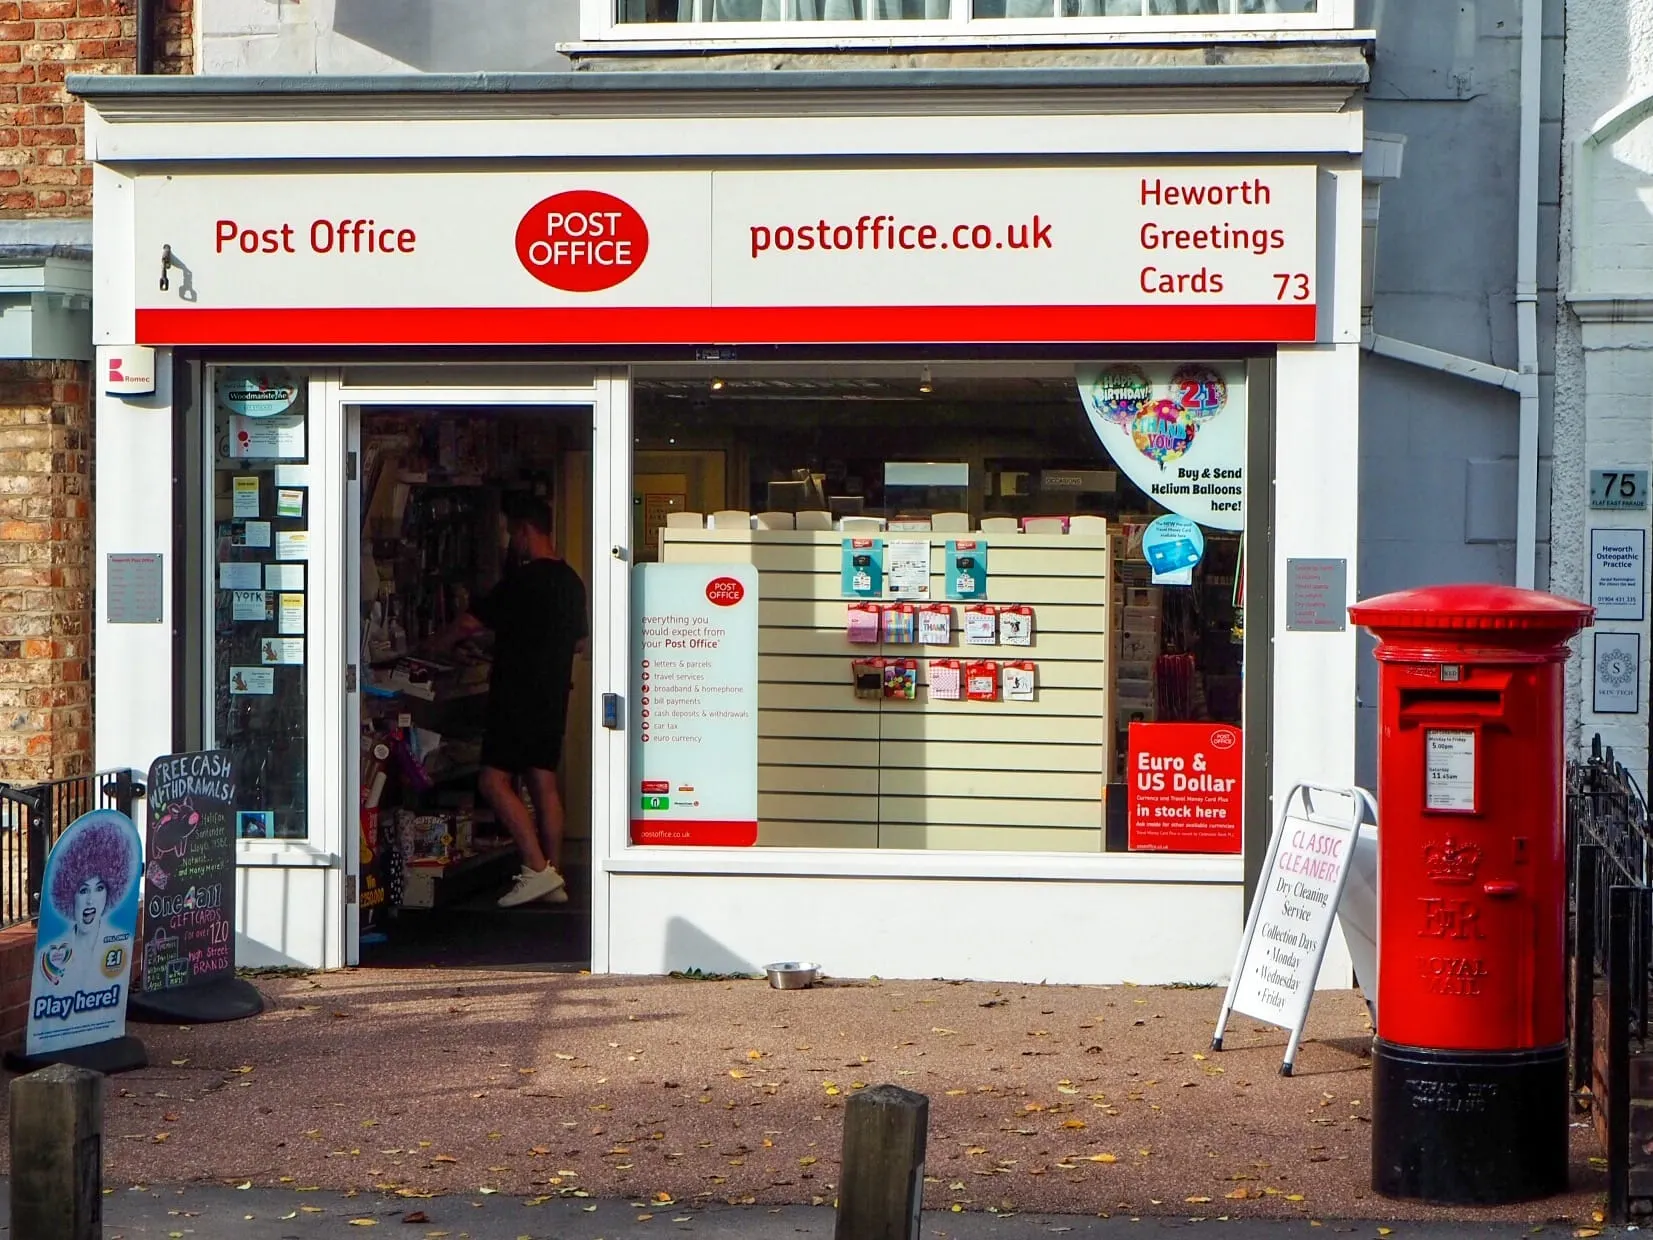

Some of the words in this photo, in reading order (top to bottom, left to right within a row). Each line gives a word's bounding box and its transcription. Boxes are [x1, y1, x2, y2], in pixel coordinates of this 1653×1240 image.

[1140, 179, 1271, 205] Heworth
[546, 211, 621, 236] POST
[215, 219, 295, 254] Post
[310, 219, 416, 254] Office
[750, 215, 1053, 258] postoffice.co.uk
[1140, 222, 1285, 255] Greetings
[528, 241, 632, 266] OFFICE
[1140, 266, 1224, 294] Cards
[1273, 273, 1310, 301] 73
[1098, 387, 1150, 401] BIRTHDAY!
[1180, 380, 1218, 408] 21
[1140, 416, 1186, 440] THANK
[1147, 433, 1174, 450] YOU
[1178, 468, 1199, 481] Buy
[1201, 468, 1211, 479] &
[1213, 468, 1242, 479] Send
[1151, 483, 1190, 495] Helium
[1192, 484, 1242, 495] Balloons
[1602, 473, 1636, 498] 75
[1211, 500, 1242, 511] here!
[709, 592, 740, 600] OFFICE
[714, 583, 736, 591] POST
[641, 616, 689, 626] everything
[692, 617, 709, 626] you
[641, 627, 669, 636] would
[671, 628, 701, 639] expect
[703, 627, 726, 636] from
[641, 641, 661, 649] your
[665, 639, 686, 648] Post
[686, 661, 712, 669] parcels
[1612, 662, 1620, 674] S
[654, 685, 692, 693] broadband
[701, 685, 744, 694] homephone
[654, 697, 665, 705] bill
[666, 698, 701, 706] payments
[671, 710, 700, 719] deposits
[709, 710, 749, 718] withdrawals
[671, 735, 702, 743] currency
[156, 757, 188, 786] FREE
[191, 755, 231, 778] CASH
[1138, 752, 1185, 771] Euro
[1192, 753, 1206, 771] &
[1137, 772, 1165, 791] US
[1173, 773, 1236, 792] Dollar
[1136, 804, 1149, 817] in
[1154, 805, 1191, 817] stock
[1196, 805, 1227, 819] here
[1292, 830, 1342, 858] CLASSIC
[1276, 877, 1292, 899] Dry
[1294, 881, 1328, 908] Cleaning
[1282, 900, 1311, 922] Service
[210, 920, 229, 945] 120
[1262, 922, 1298, 945] Collection
[1297, 932, 1317, 954] Days
[106, 948, 122, 967] £1
[193, 959, 228, 976] BRANDS
[1271, 946, 1300, 974] Monday
[1261, 965, 1301, 995] Wednesday
[35, 996, 71, 1018] Play
[75, 986, 118, 1011] here!
[1261, 988, 1287, 1012] Friday
